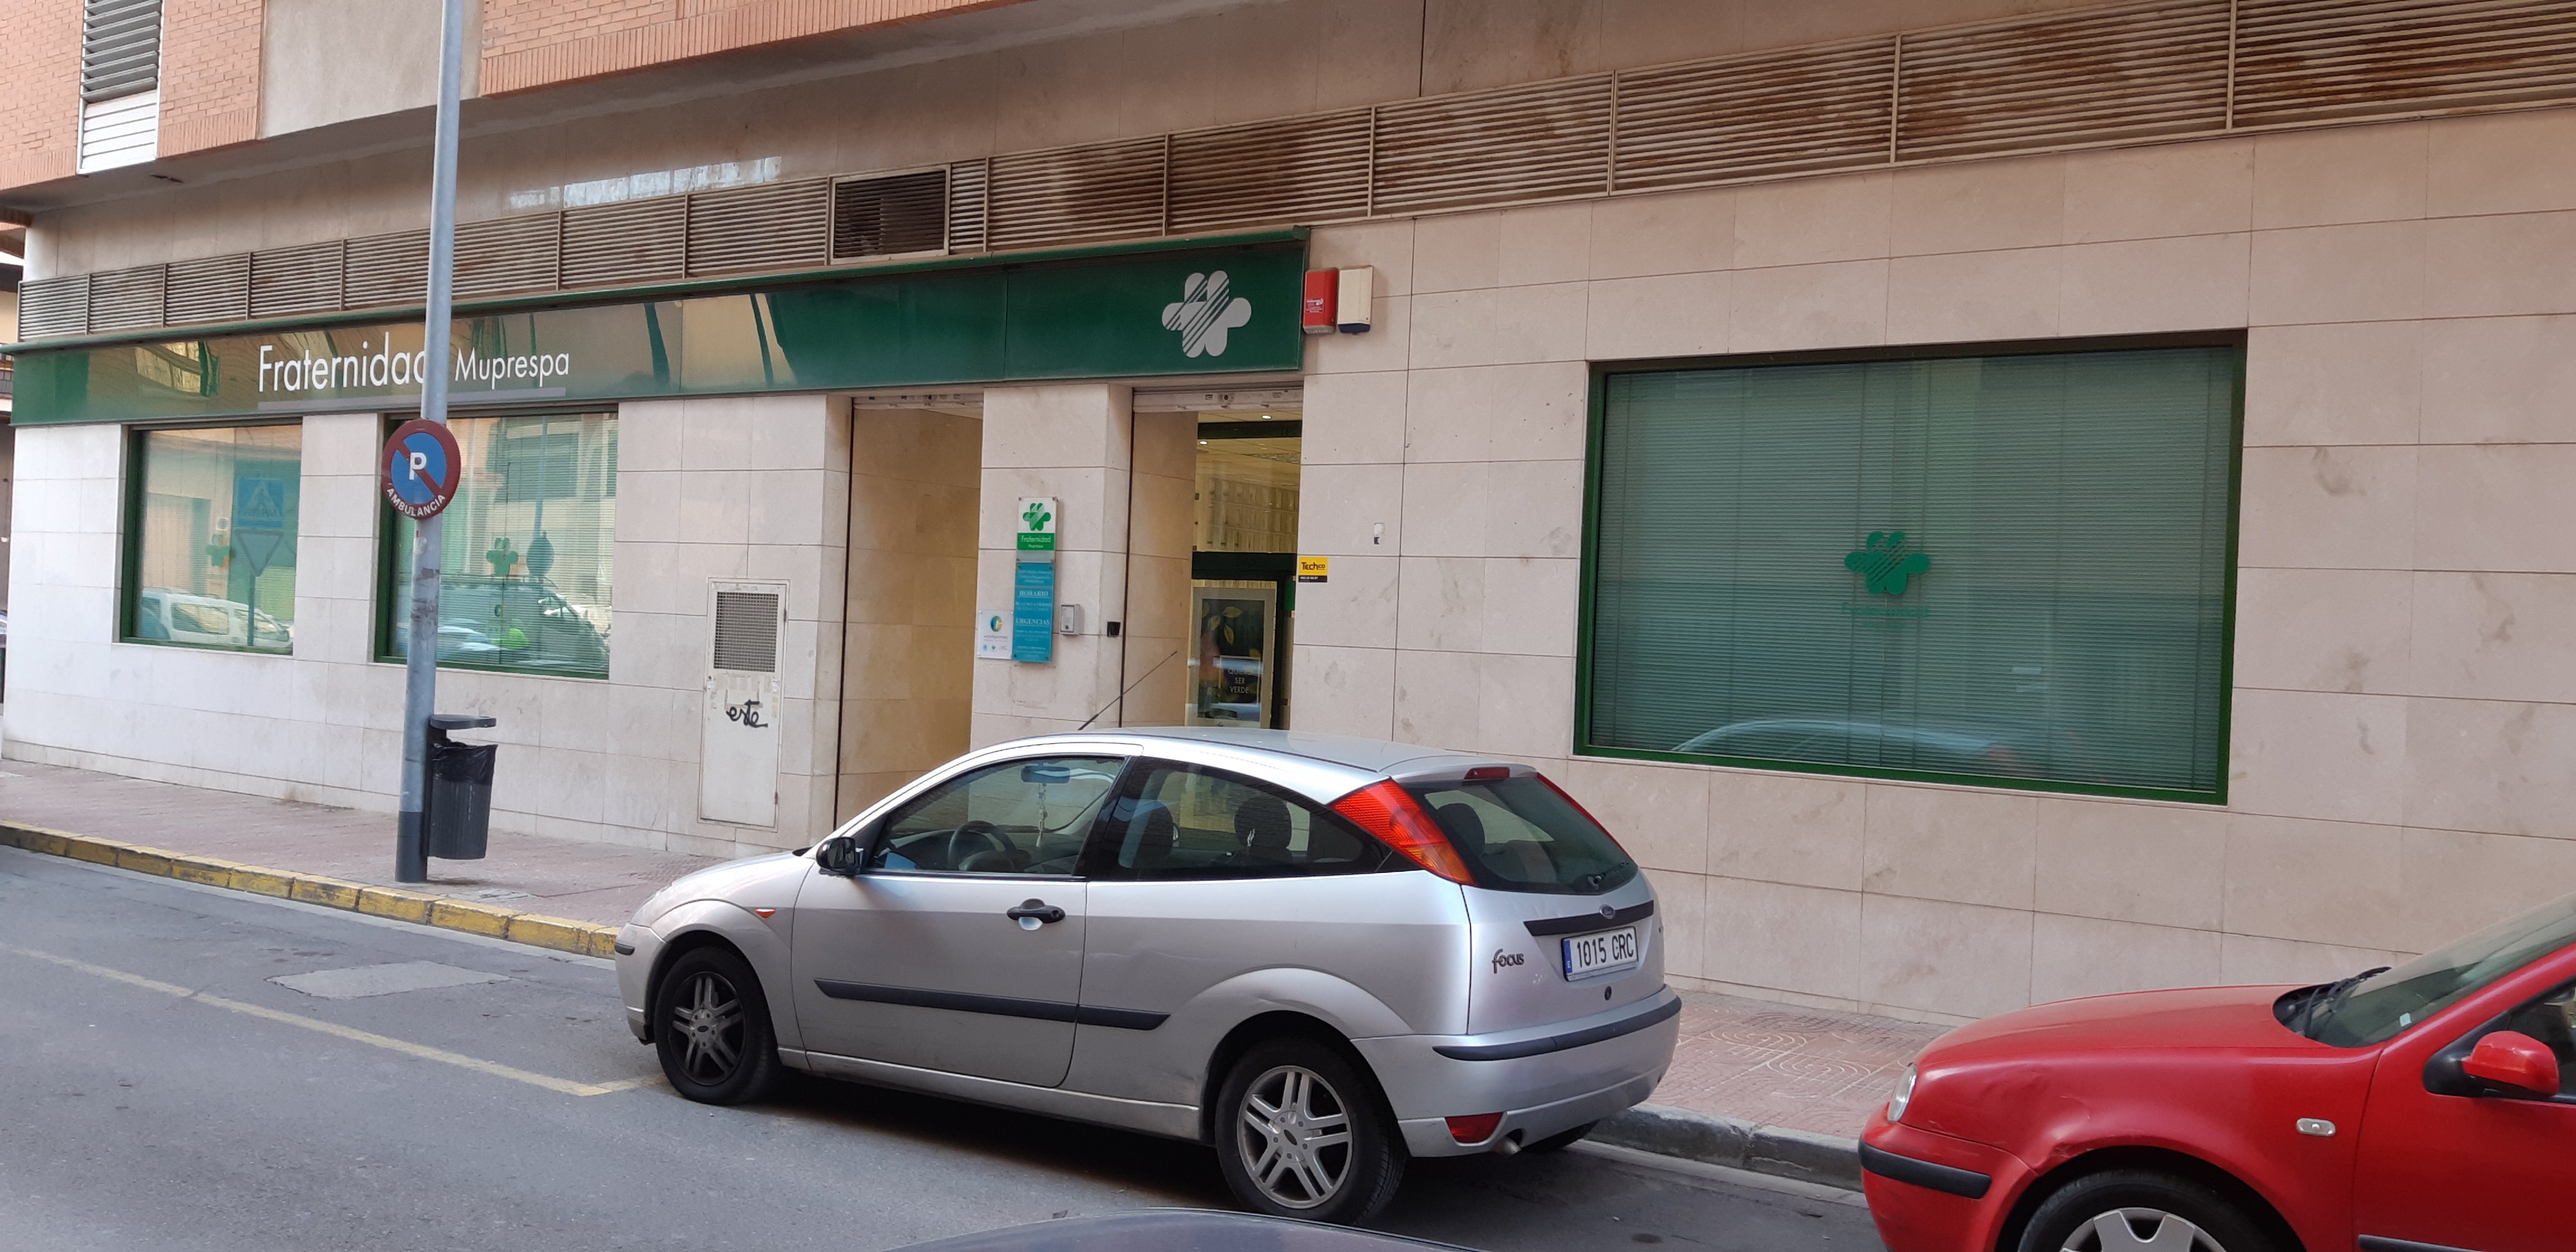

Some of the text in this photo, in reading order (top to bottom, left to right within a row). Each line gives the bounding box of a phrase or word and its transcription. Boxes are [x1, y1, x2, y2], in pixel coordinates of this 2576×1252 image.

[455, 348, 570, 390] Muprespa
[409, 452, 427, 480] P
[387, 488, 446, 516] AMBULANCIA
[1577, 933, 1633, 968] 1015 CRC
